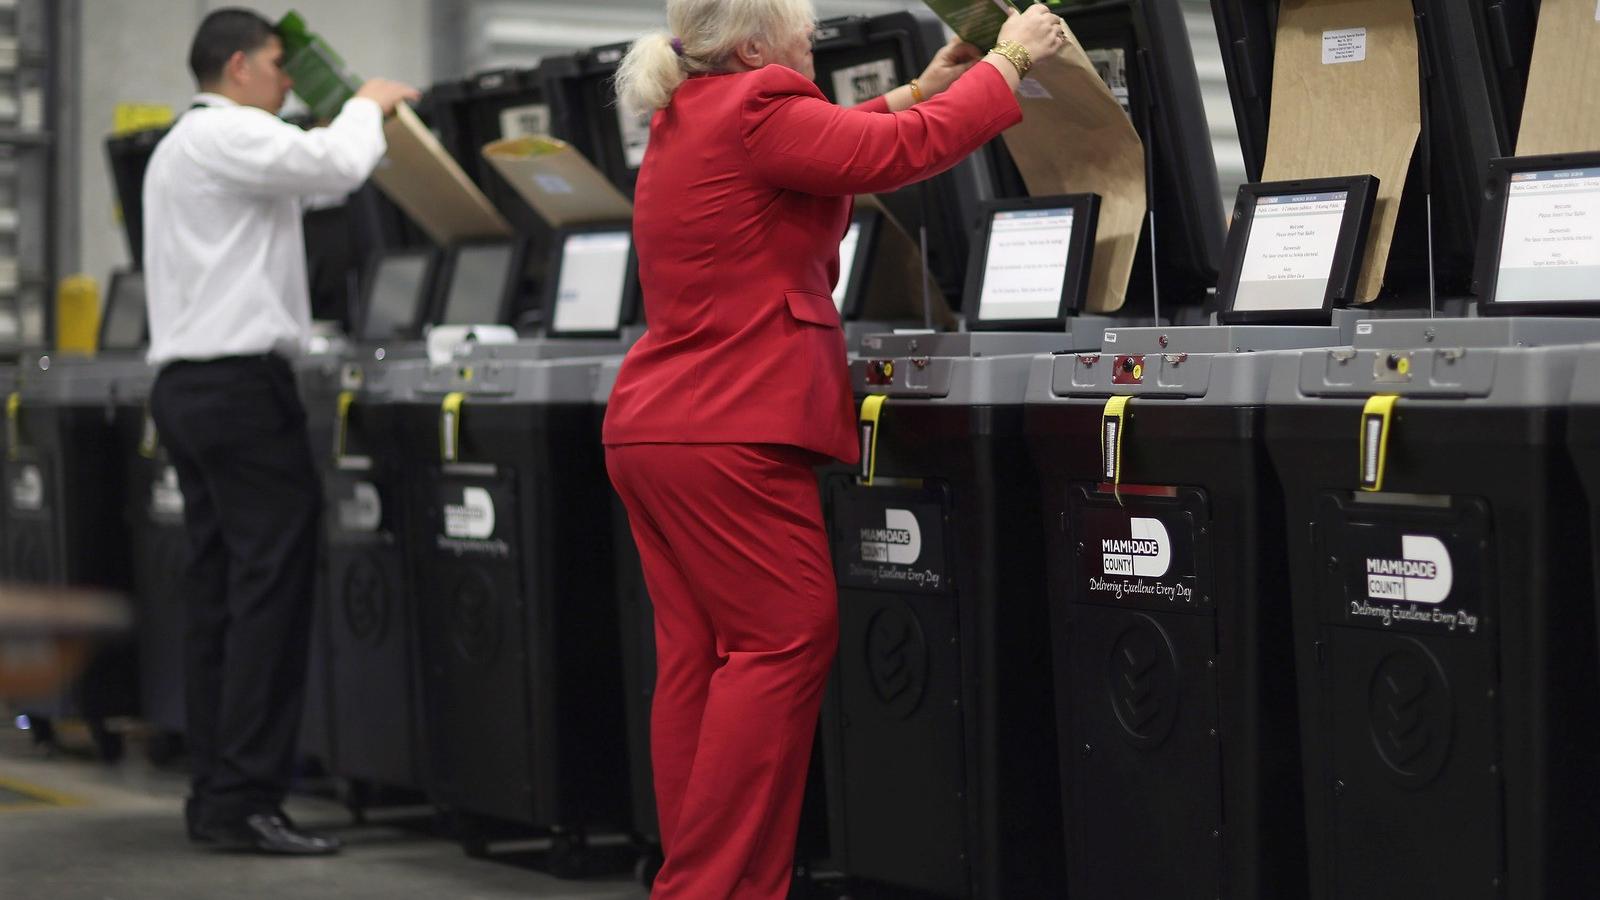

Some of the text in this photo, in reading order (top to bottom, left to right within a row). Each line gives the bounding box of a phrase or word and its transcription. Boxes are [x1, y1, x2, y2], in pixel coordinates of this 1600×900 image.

[860, 528, 909, 543] MIAMI-DADE
[1102, 539, 1158, 554] MIAMI-DADE
[1104, 558, 1131, 572] COUNTY
[1367, 558, 1436, 578] MIAMI-DADE
[908, 568, 925, 586] Every
[925, 569, 940, 588] Day
[1089, 576, 1192, 602] Delivering Excellence Every Day
[1369, 580, 1402, 595] COUNTY
[1351, 600, 1478, 632] Delivering Excellence Every Day
